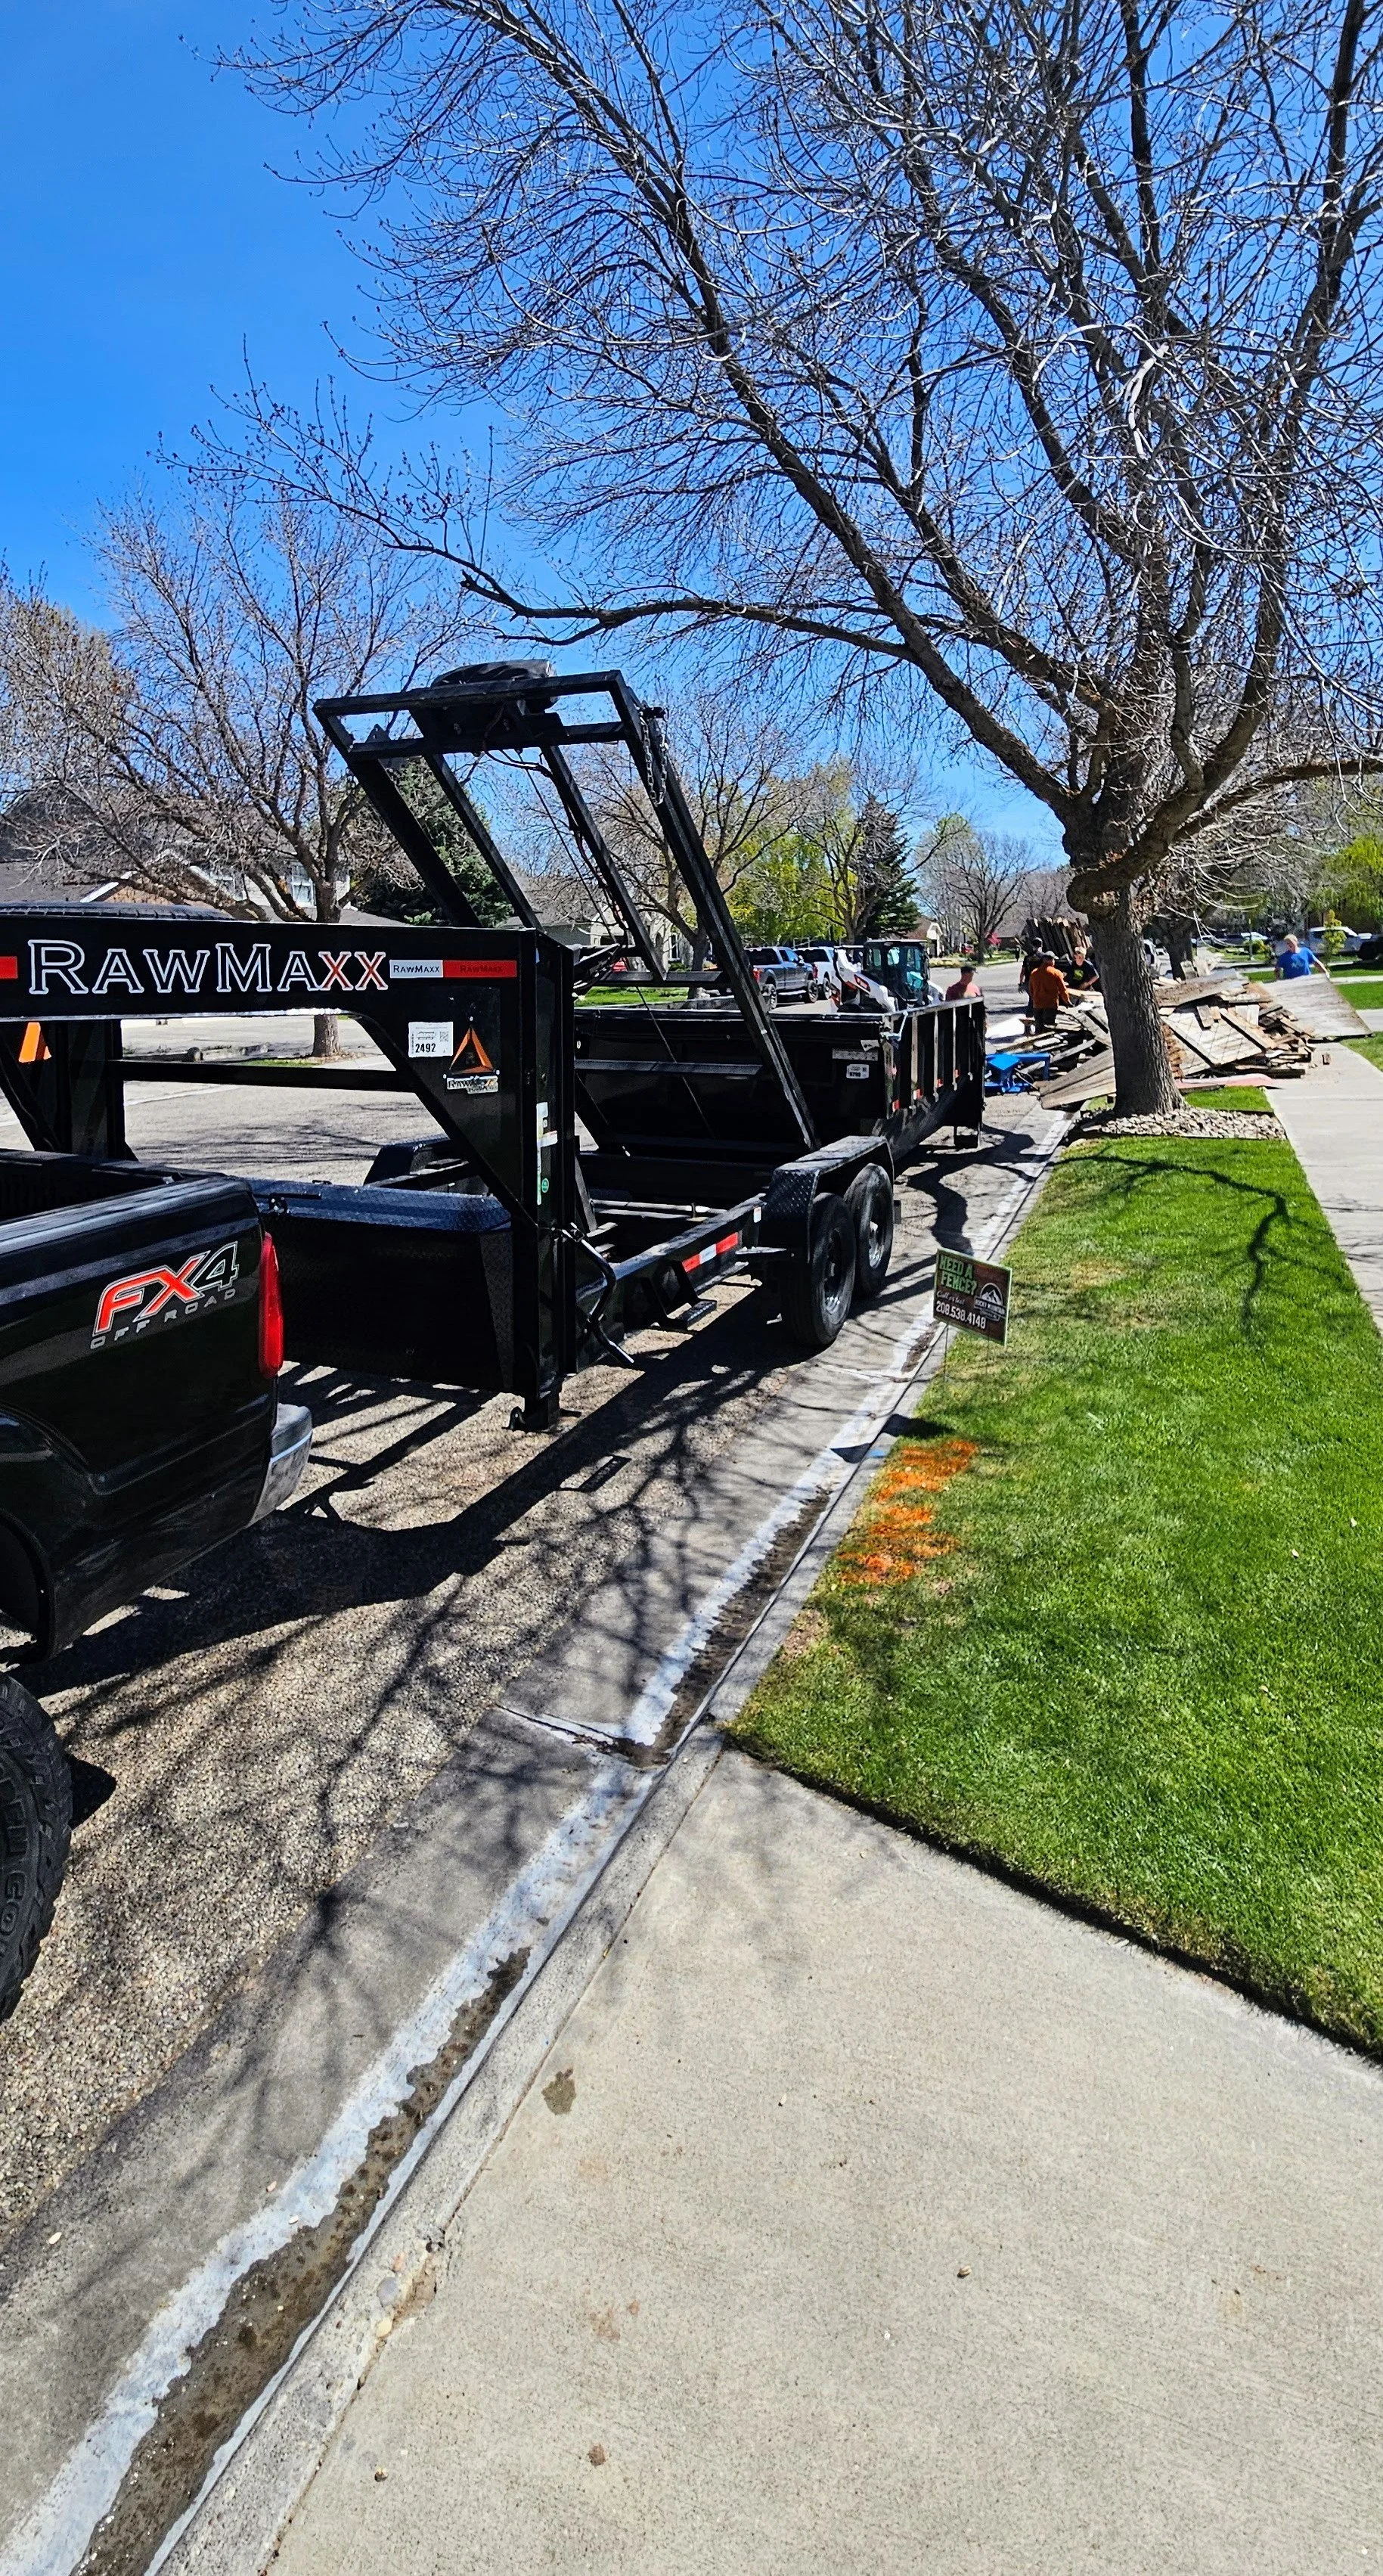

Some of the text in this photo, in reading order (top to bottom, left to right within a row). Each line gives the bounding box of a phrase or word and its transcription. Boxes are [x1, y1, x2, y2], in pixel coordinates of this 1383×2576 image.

[415, 1043, 436, 1053] 2492
[940, 1255, 972, 1279] NEED A
[92, 1241, 240, 1336] FX4
[941, 1271, 977, 1295] FENCE?
[90, 1288, 236, 1349] OFF ROAD
